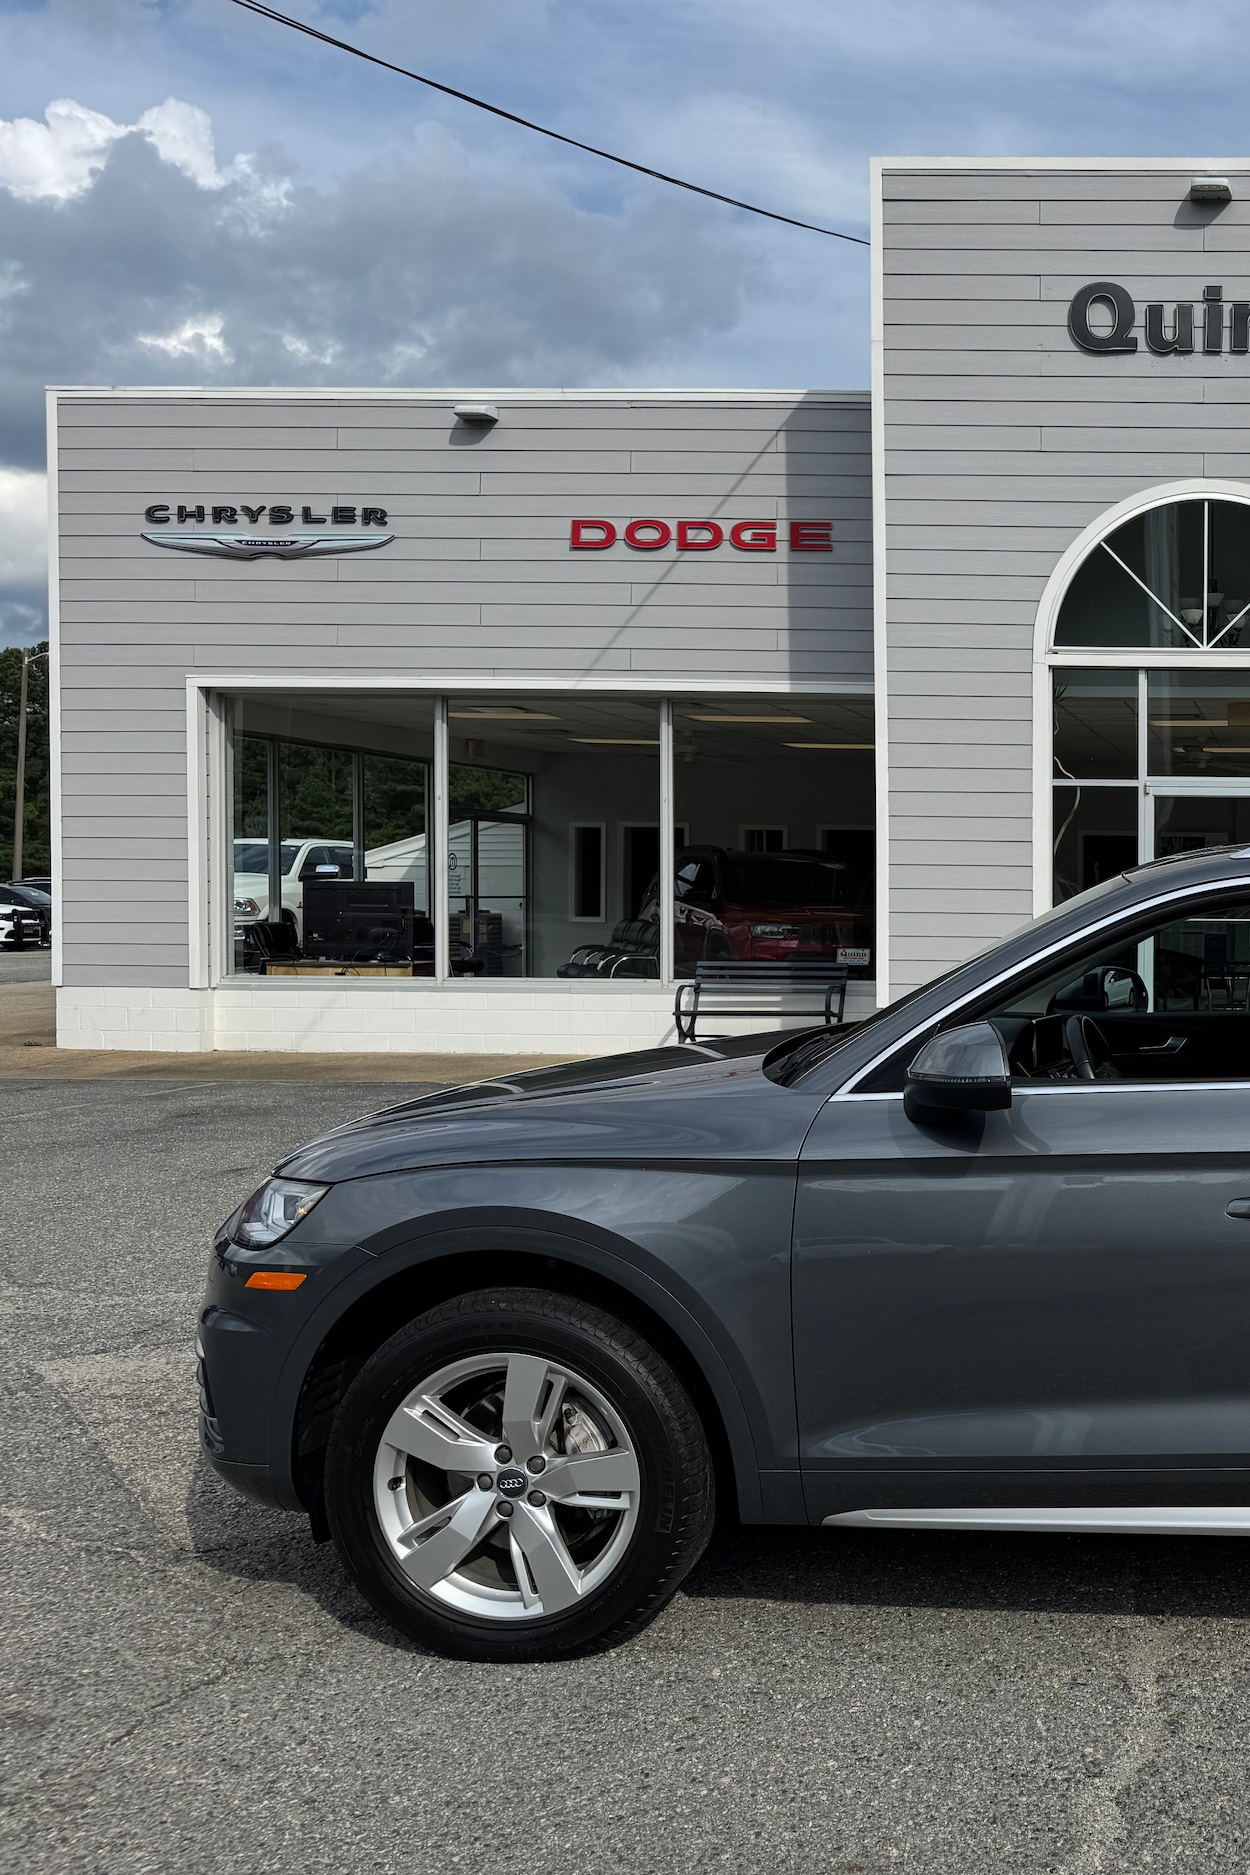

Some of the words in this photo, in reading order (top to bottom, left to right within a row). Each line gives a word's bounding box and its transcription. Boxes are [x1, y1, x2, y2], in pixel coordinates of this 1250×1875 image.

[145, 504, 388, 525] CHRYSLER
[570, 519, 833, 551] DODGE
[840, 949, 867, 958] Quinn
